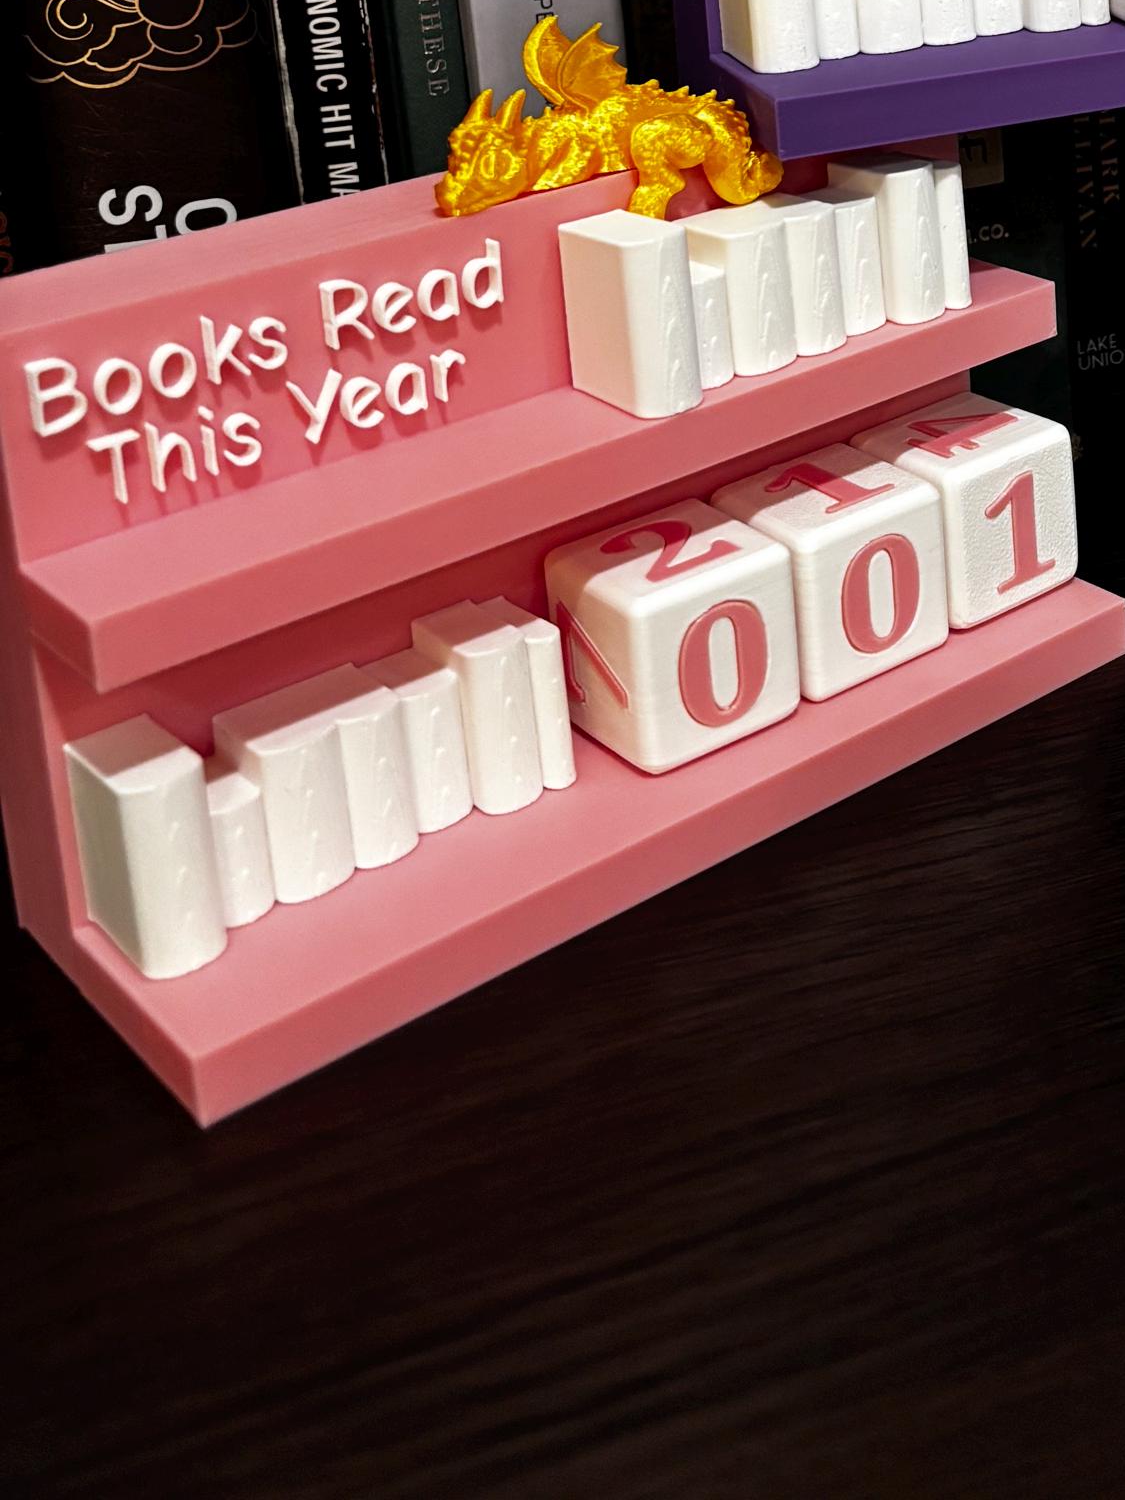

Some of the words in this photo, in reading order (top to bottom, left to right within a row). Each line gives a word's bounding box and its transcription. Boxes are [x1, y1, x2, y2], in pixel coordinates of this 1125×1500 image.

[320, 103, 356, 150] HIT
[23, 315, 289, 437] Books
[319, 238, 504, 350] Read
[1077, 333, 1117, 356] LAKE
[86, 405, 263, 504] This
[286, 348, 466, 445] Year
